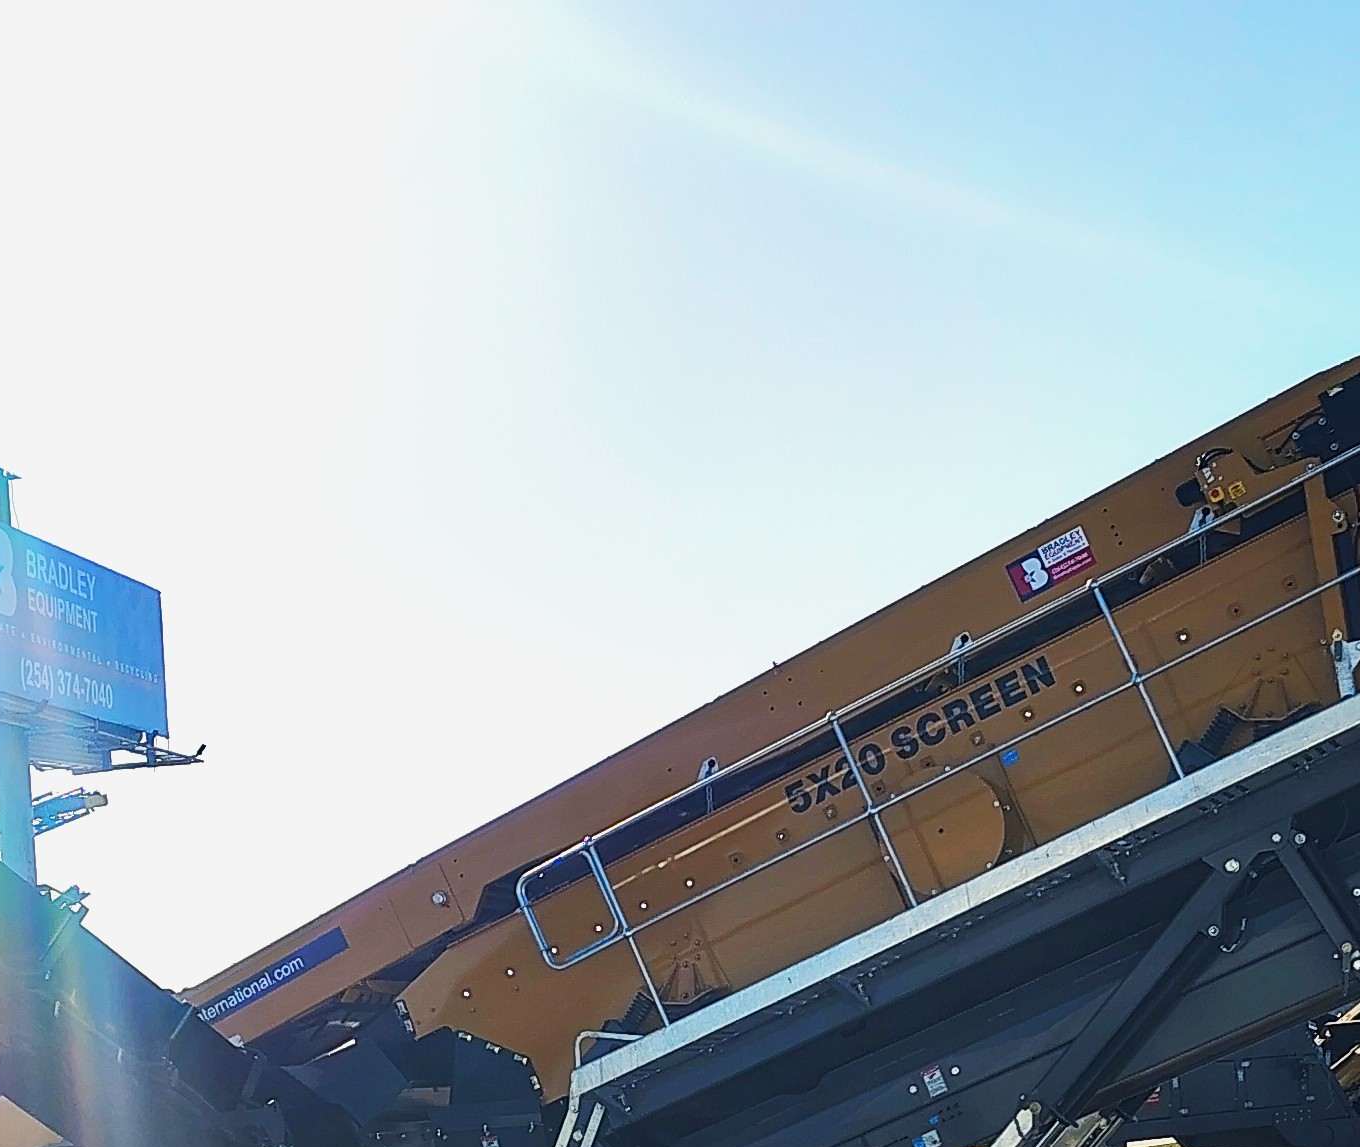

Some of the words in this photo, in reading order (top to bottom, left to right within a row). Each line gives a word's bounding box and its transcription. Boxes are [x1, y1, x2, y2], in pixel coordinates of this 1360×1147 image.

[1041, 529, 1081, 555] BRADLEY
[26, 549, 96, 601] BRADLEY
[27, 588, 98, 633] EQUIPMENT
[20, 657, 54, 699] (254)
[57, 669, 113, 709] 374-7040
[31, 634, 102, 665] ENVIRONMENTAL
[114, 660, 159, 684] RECYCLING
[785, 743, 886, 813] 5X20
[890, 655, 1057, 760] SCREEN
